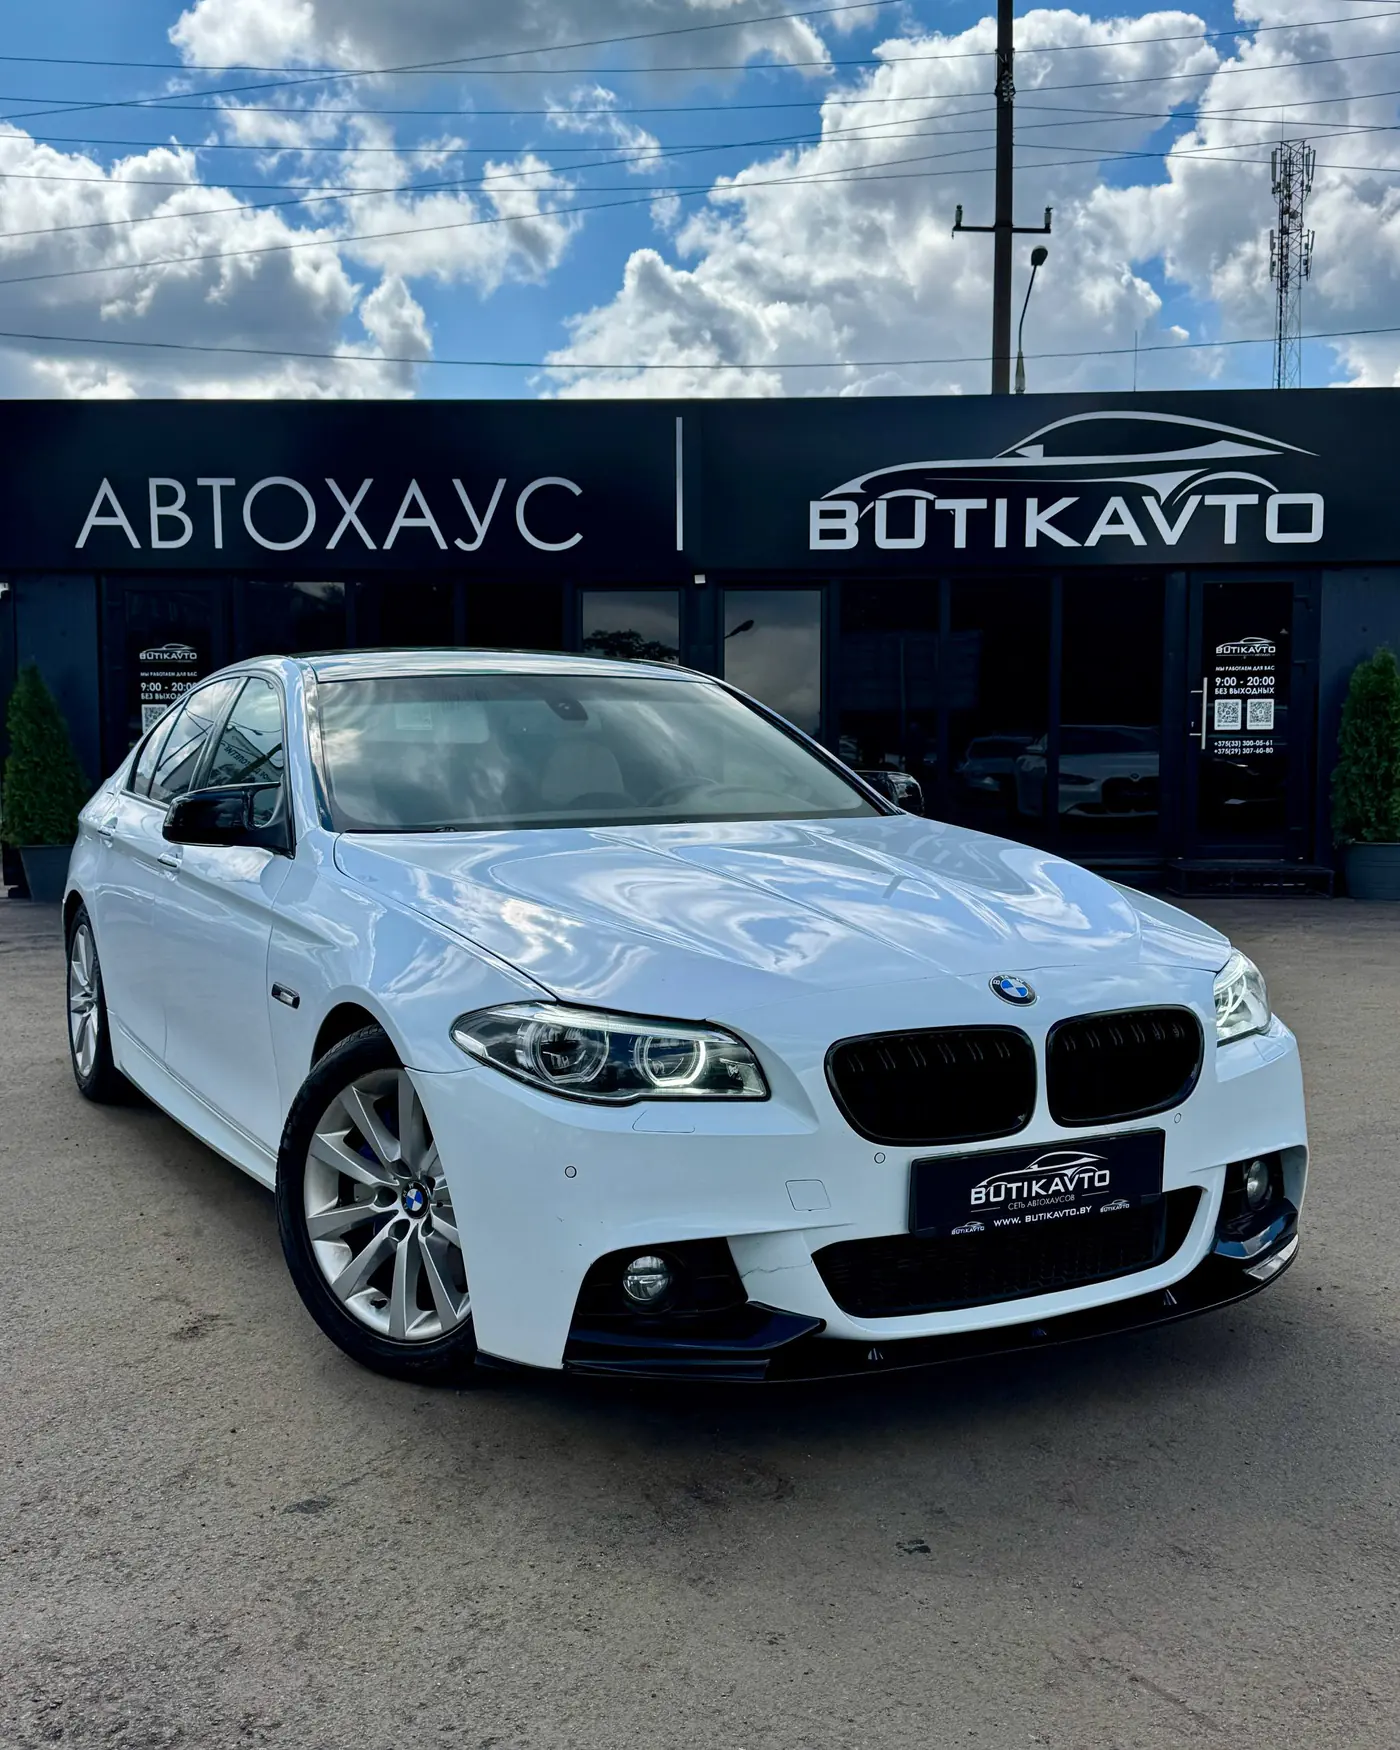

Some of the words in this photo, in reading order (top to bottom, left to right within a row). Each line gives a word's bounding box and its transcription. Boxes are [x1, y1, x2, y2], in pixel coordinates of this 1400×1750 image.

[75, 477, 583, 551] АВТОХАУС
[809, 492, 1325, 550] BUTIKAVTO
[1215, 645, 1276, 654] BUTIKAVTO
[139, 652, 198, 660] BUTIKAVTO
[1215, 676, 1237, 686] 9:00
[1246, 676, 1275, 686] 20:00
[140, 682, 162, 692] 9:00
[1229, 687, 1275, 695] ВЫХОДНЫХ
[970, 1169, 1110, 1205] BUTIKAVTO
[1008, 1202, 1026, 1211] СЕТЬ
[1027, 1194, 1076, 1208] АВТОХАУСОВ
[993, 1217, 1022, 1227] WWW.
[1025, 1205, 1092, 1223] BUTIKAVTO.BY
[951, 1226, 985, 1235] BUTIKAVTO
